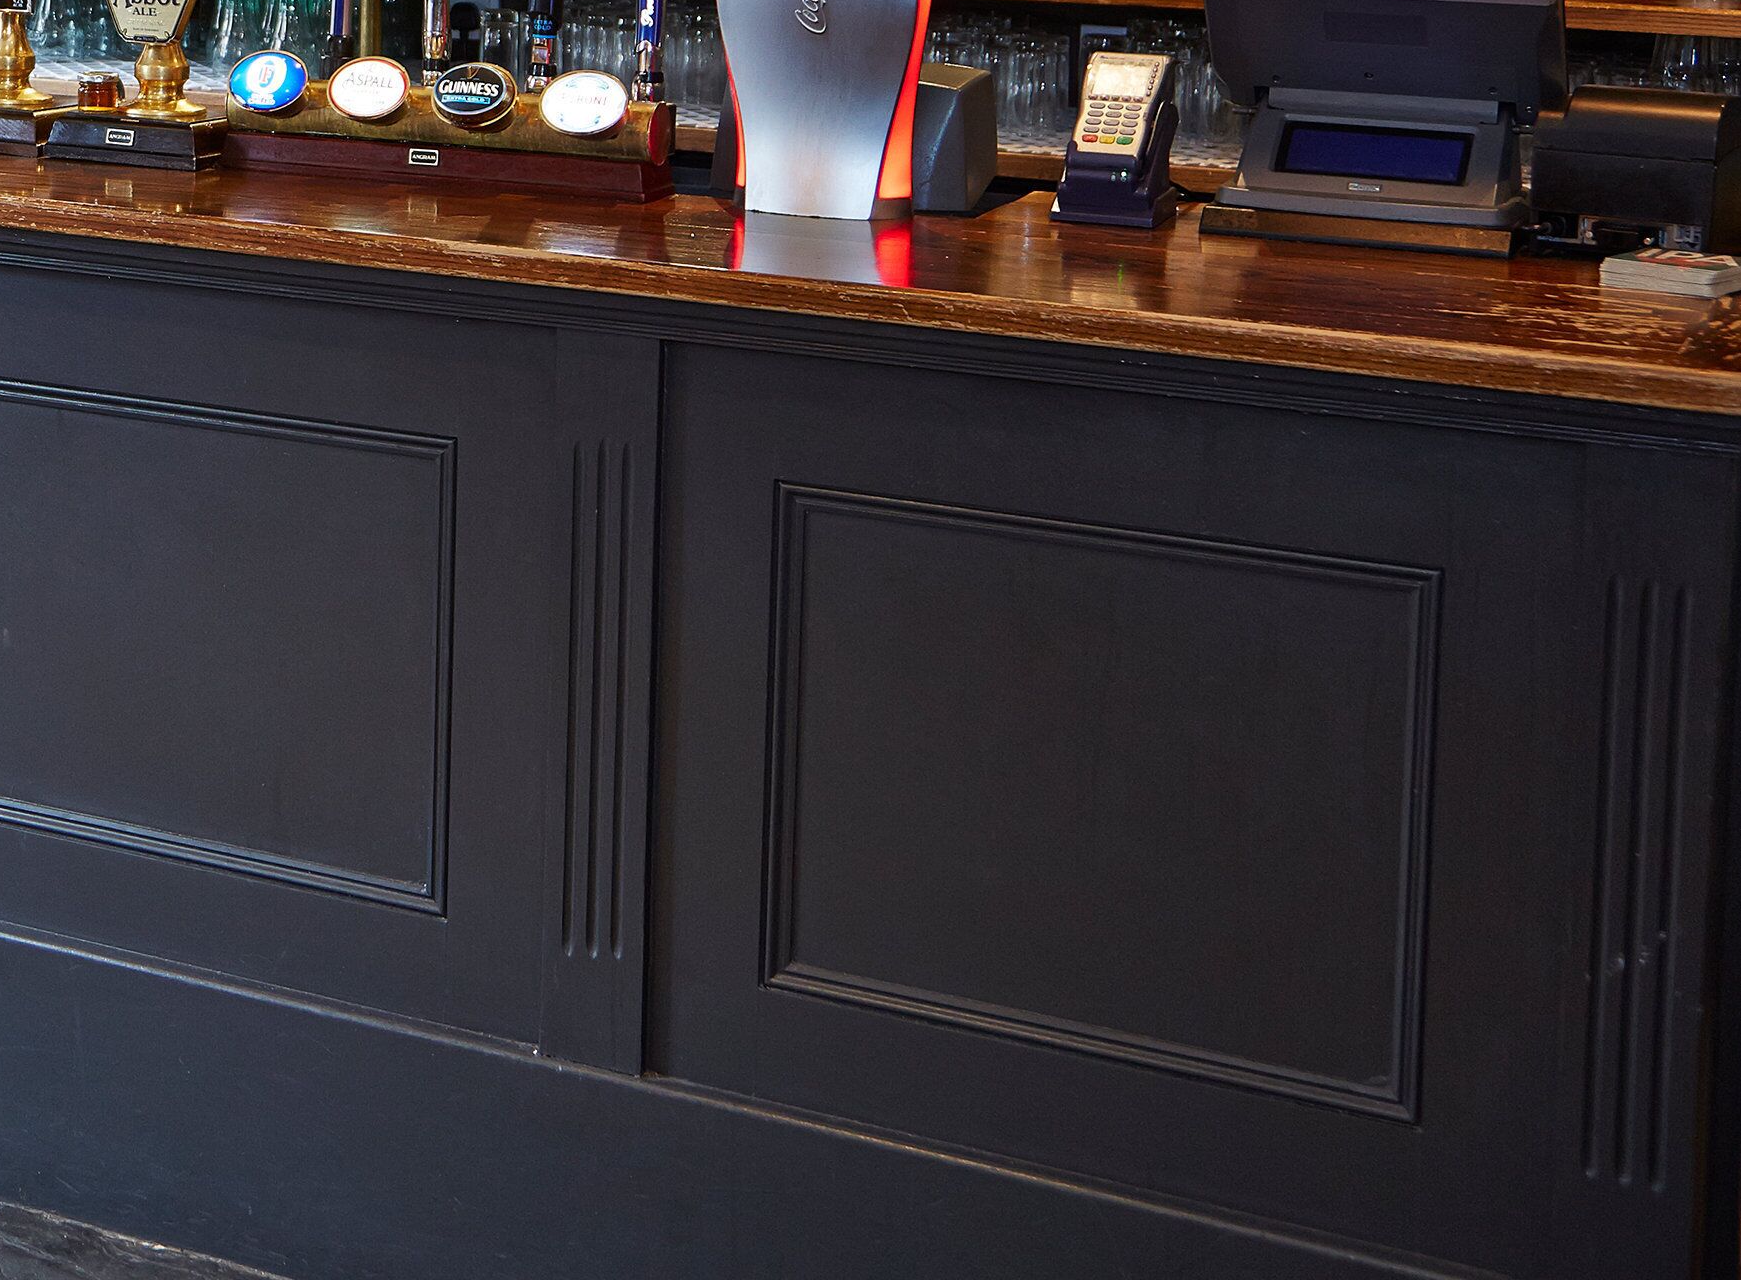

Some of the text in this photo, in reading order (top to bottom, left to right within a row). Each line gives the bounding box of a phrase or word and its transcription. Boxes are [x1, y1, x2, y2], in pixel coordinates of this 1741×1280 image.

[132, 7, 158, 16] ALE
[342, 71, 394, 89] ASPALL
[438, 79, 500, 97] GUINNESS
[1635, 248, 1739, 267] IPA
